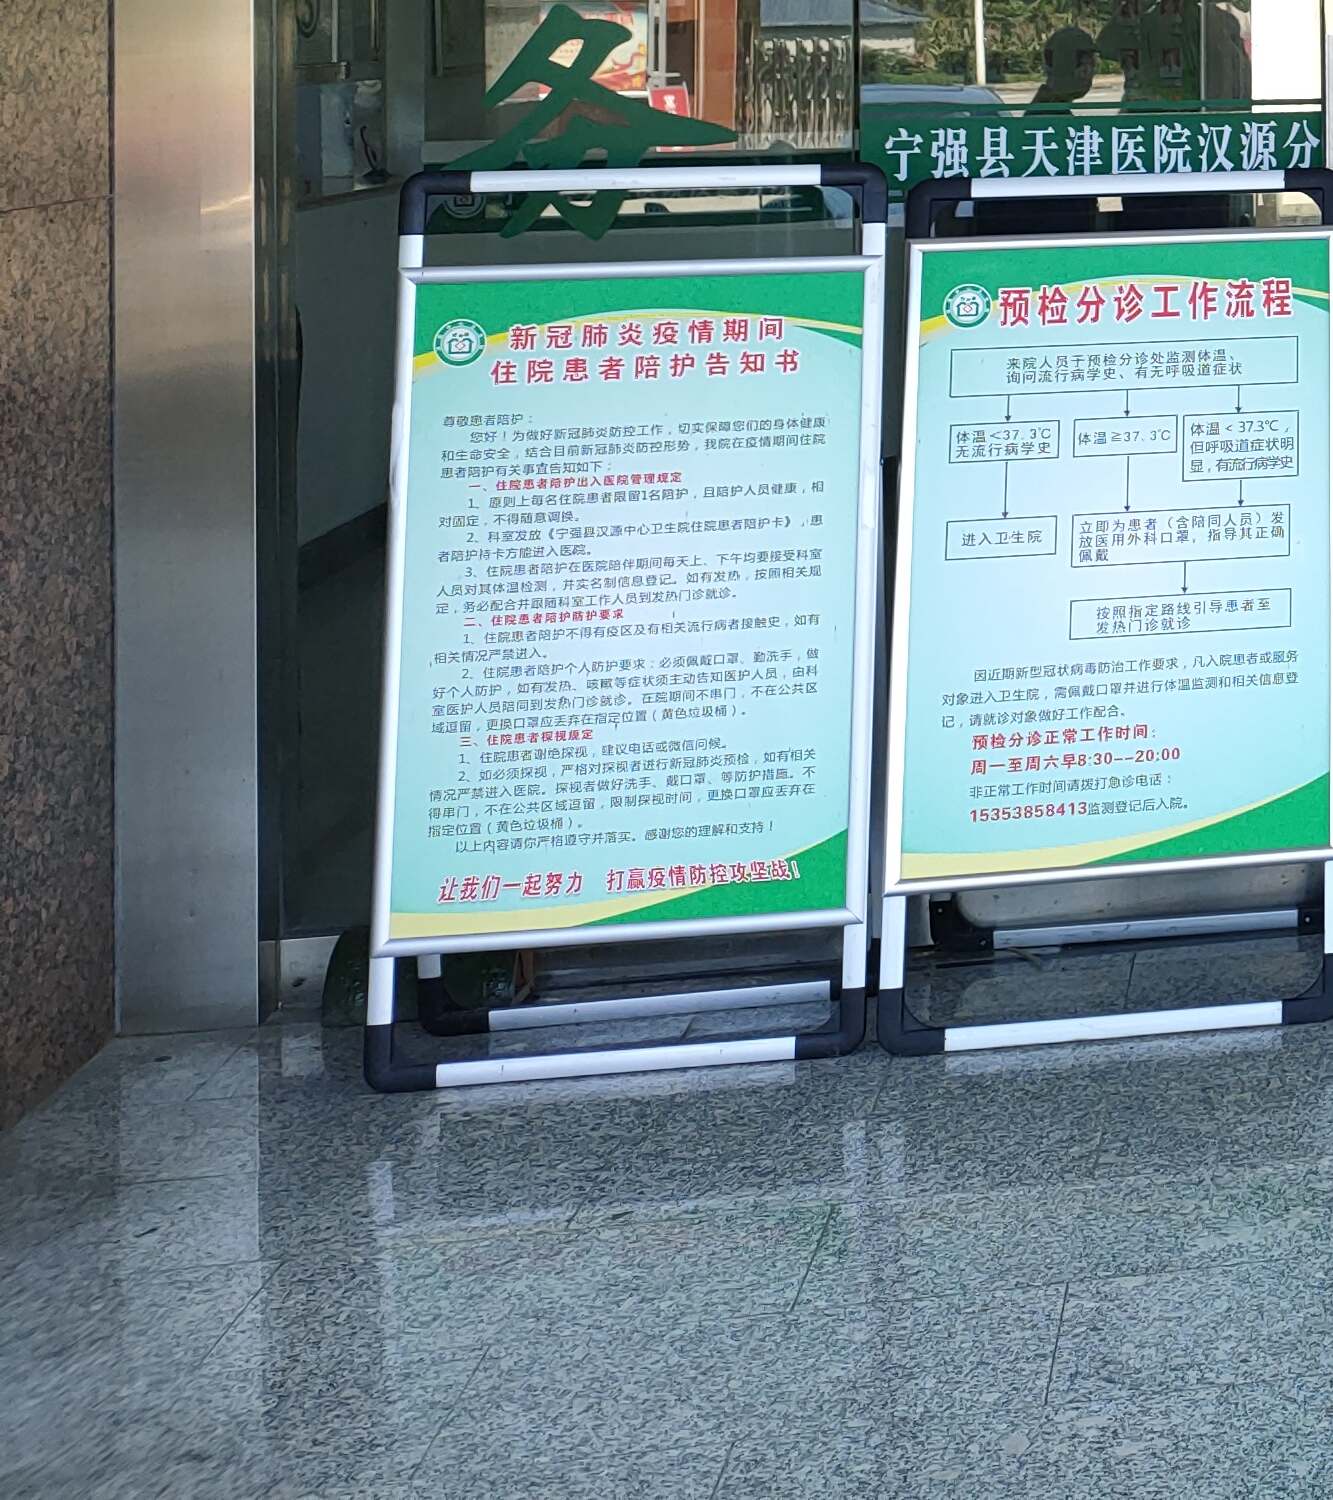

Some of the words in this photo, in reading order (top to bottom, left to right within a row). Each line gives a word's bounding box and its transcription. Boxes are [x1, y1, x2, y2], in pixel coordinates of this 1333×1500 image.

[999, 278, 1293, 327] 预检分诊工作流程
[508, 317, 785, 351] 新冠肺炎疫情期间
[491, 348, 800, 386] 住院患者陪护告知书
[955, 441, 1051, 459] 无流行病学史
[1190, 436, 1295, 455] 但呼吸道症状明
[961, 529, 1043, 547] 进入卫生院
[1096, 597, 1271, 621] 按照指定路线引导患者至
[1096, 616, 1192, 635] 发热门诊就诊
[438, 870, 583, 903] 让我们一起努力
